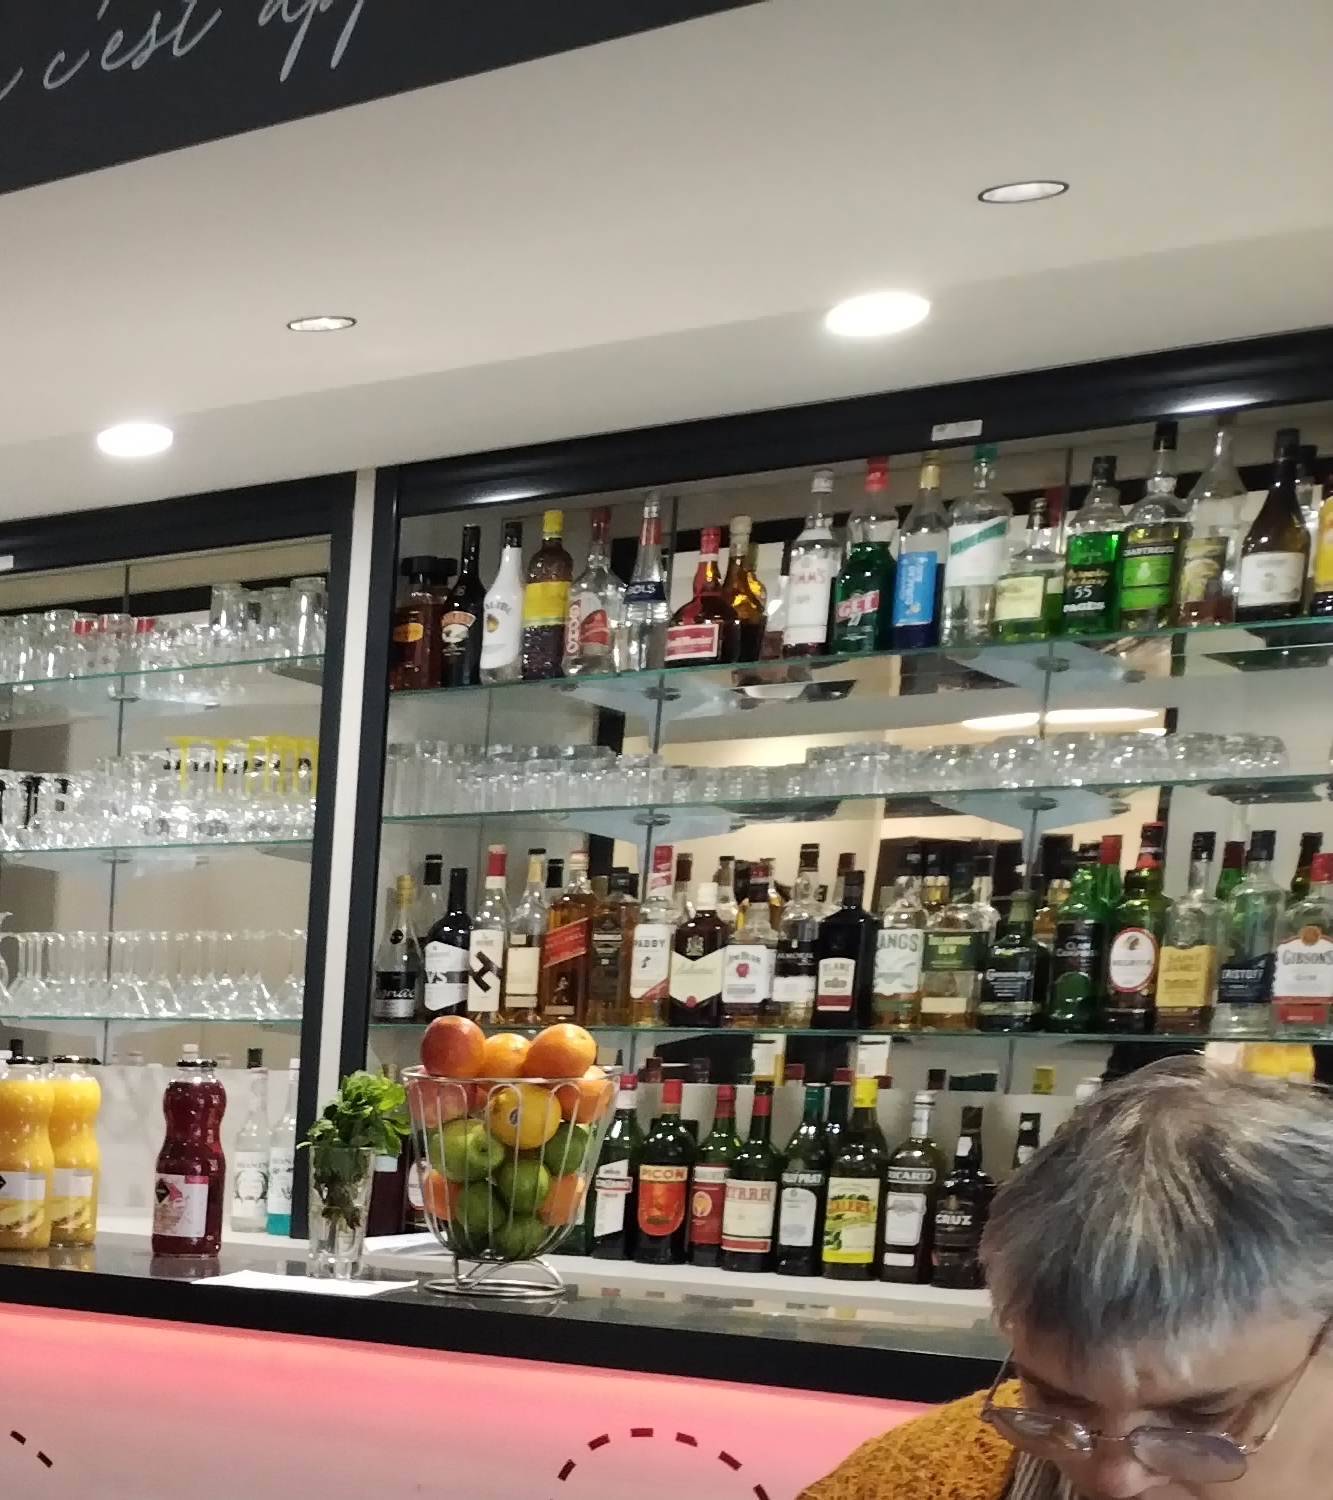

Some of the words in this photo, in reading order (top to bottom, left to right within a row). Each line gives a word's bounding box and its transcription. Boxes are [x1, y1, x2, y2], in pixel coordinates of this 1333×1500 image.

[837, 590, 879, 617] GET
[877, 933, 920, 952] ANGS
[641, 1168, 687, 1180] PICON
[935, 1213, 973, 1226] CRUZ
